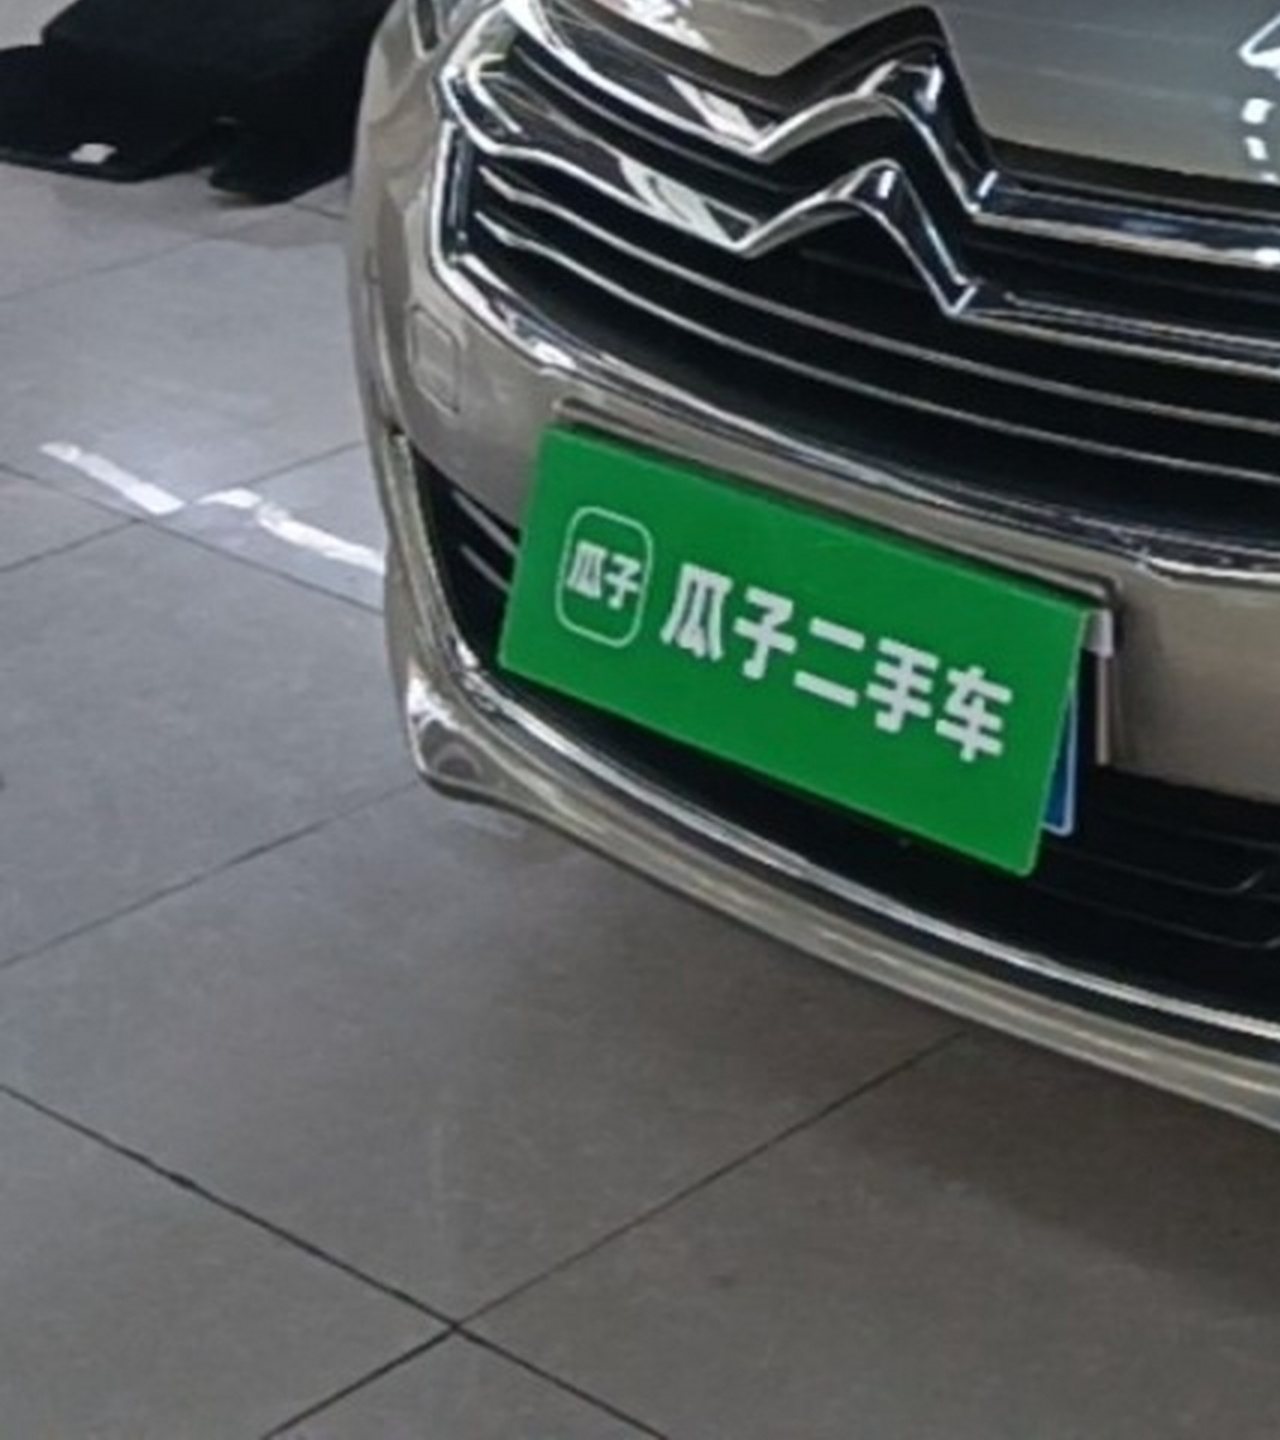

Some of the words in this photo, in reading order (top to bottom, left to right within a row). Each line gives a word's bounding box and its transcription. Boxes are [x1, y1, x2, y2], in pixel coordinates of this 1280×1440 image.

[565, 540, 643, 609] 瓜子
[660, 563, 1012, 761] 瓜子二手车
